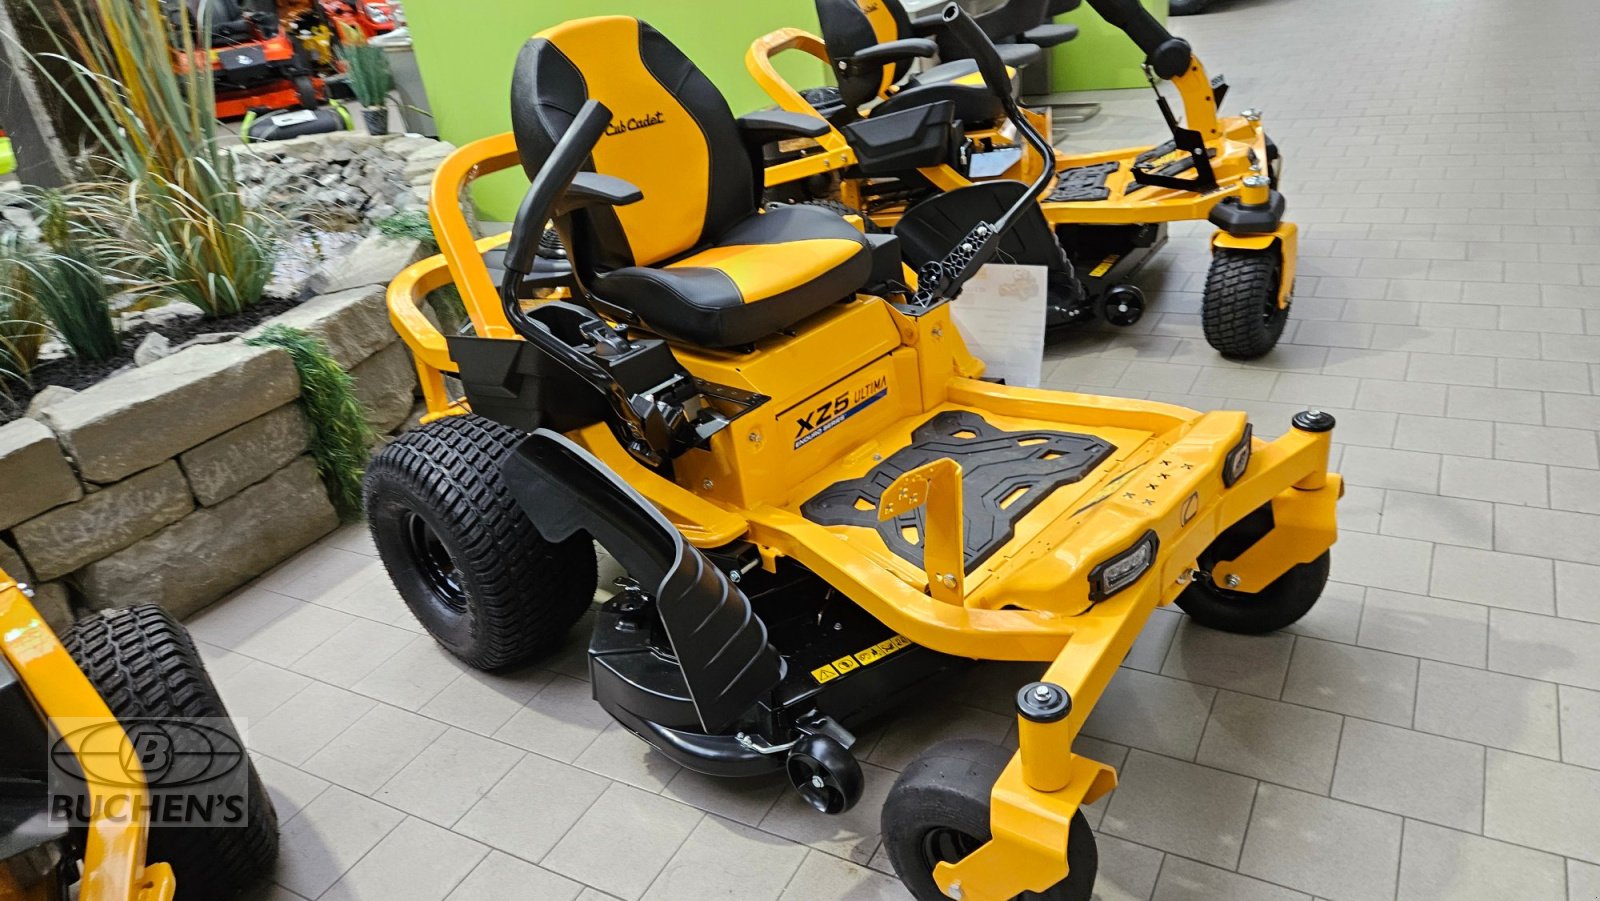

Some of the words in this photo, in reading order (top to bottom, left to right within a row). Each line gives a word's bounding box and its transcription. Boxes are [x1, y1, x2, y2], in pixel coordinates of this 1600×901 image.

[605, 120, 626, 137] Cub
[627, 111, 665, 131] Cadet
[795, 391, 849, 438] XZ5
[854, 375, 887, 404] ULTIMA
